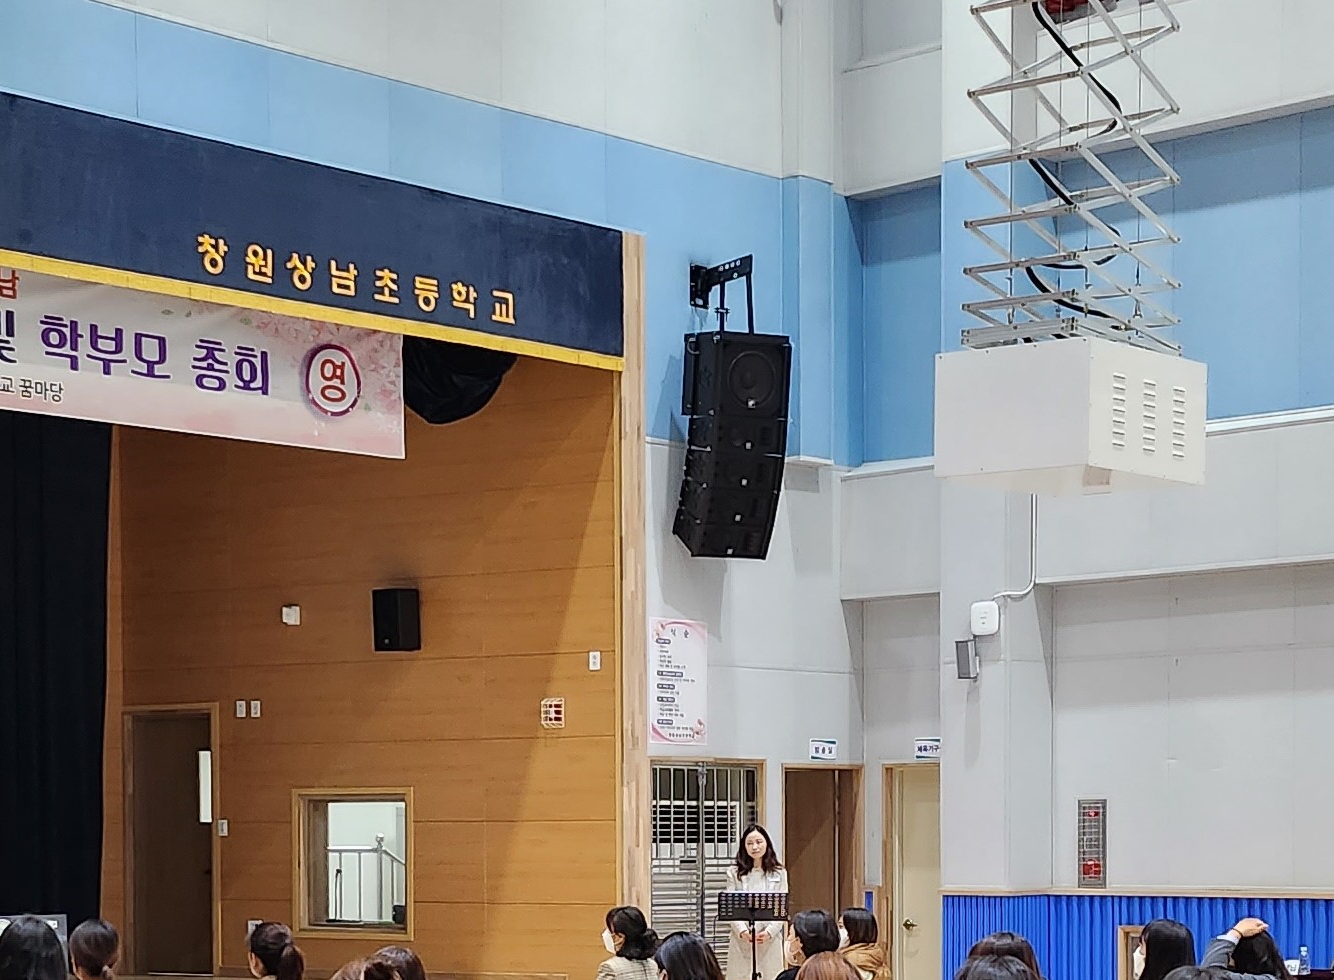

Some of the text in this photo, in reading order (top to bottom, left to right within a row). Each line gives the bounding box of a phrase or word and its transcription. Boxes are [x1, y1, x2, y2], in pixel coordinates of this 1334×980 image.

[196, 232, 517, 325] 창원상남초등학교
[39, 314, 172, 383] 학부모
[190, 337, 271, 396] 총회
[18, 379, 65, 404] 꿈마당
[320, 357, 347, 402] 영
[917, 745, 940, 754] 체육기구
